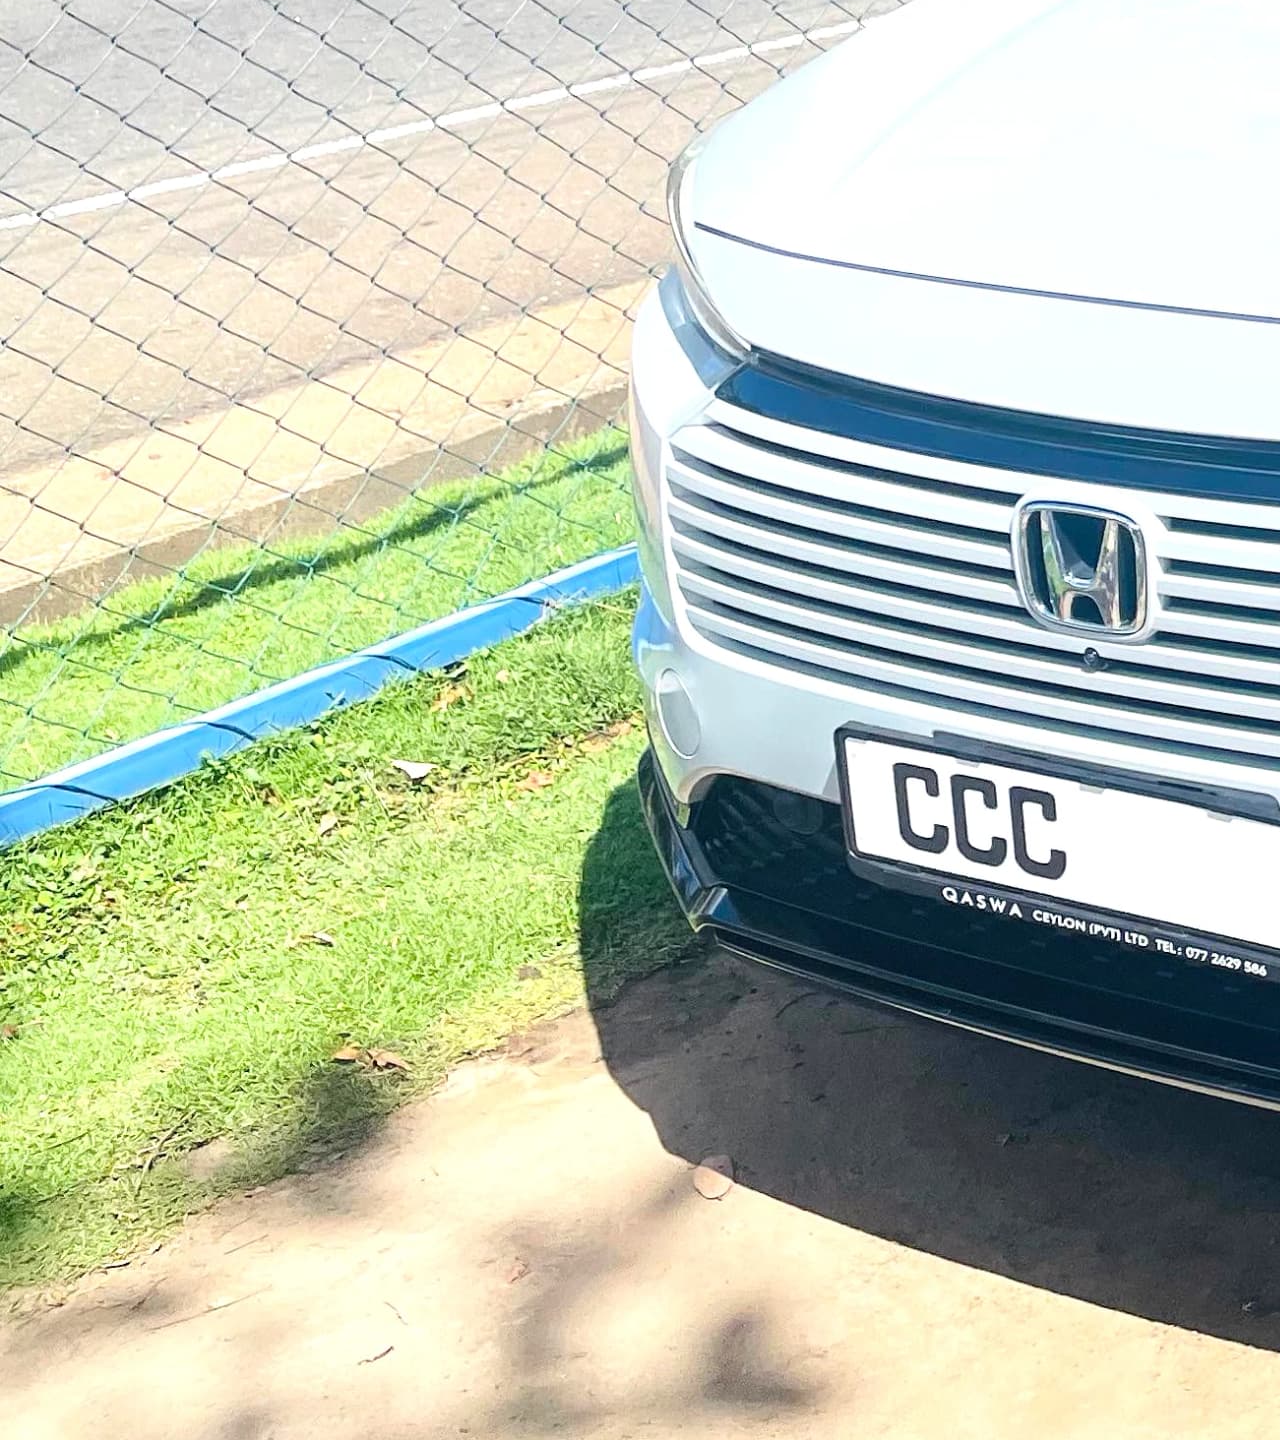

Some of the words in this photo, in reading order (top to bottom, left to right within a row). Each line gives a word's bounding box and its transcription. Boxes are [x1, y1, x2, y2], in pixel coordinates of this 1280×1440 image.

[893, 762, 1067, 880] CCC
[942, 886, 1023, 918] QASWA
[1032, 909, 1086, 932] CEYLON
[1089, 922, 1121, 941] (PVT)
[1124, 931, 1149, 947] LTD
[1155, 938, 1183, 956] TEL:
[1185, 946, 1208, 962] 077
[1211, 953, 1242, 970] 2629
